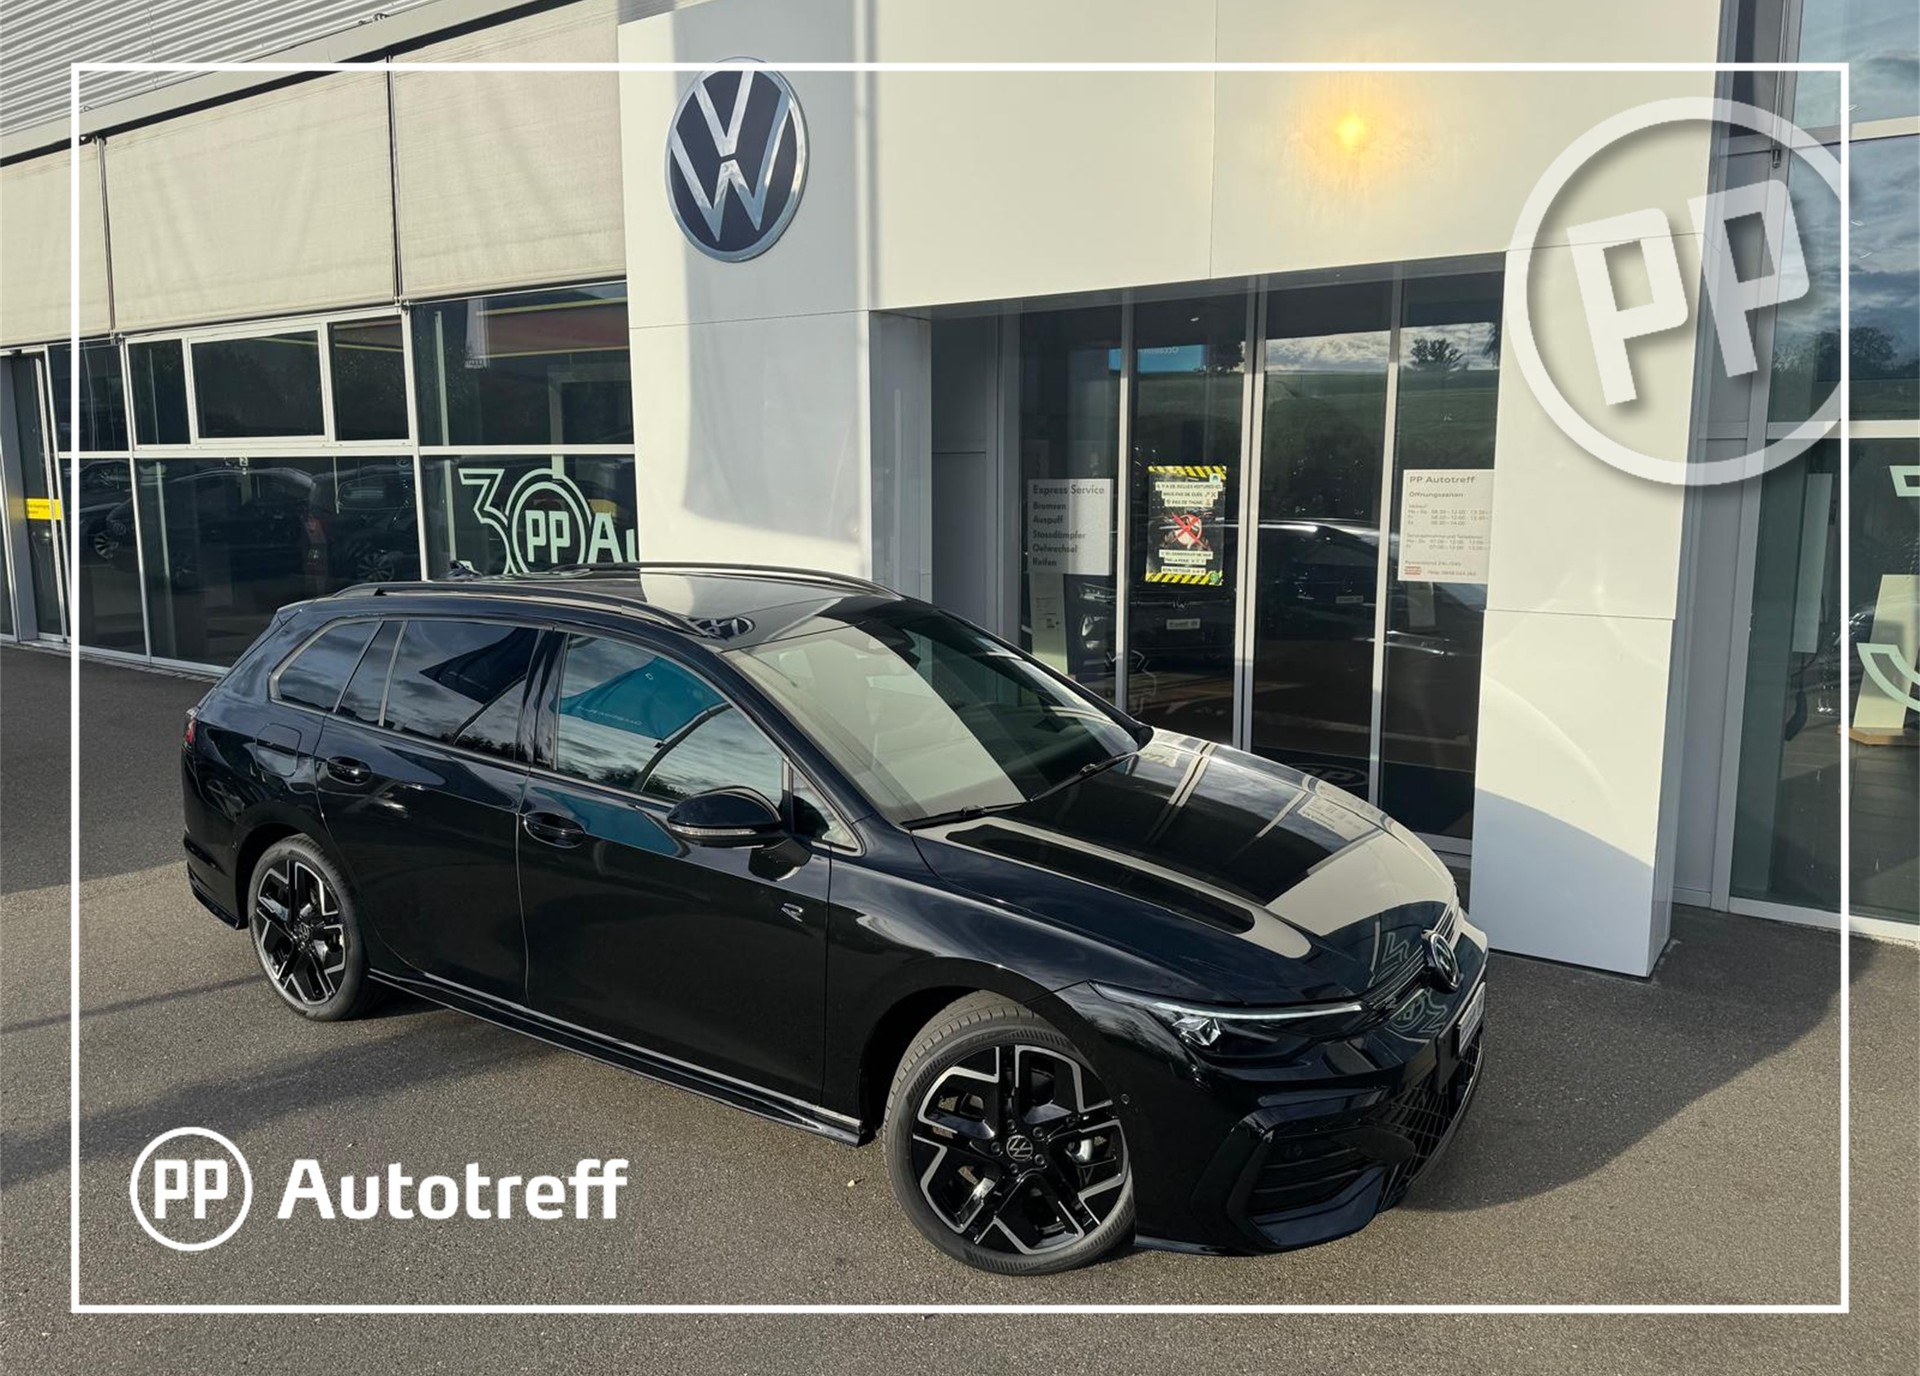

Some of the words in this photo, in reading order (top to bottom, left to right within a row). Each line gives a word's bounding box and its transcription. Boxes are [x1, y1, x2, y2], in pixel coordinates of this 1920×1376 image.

[669, 66, 797, 243] VW
[1033, 484, 1068, 495] Express
[1070, 484, 1105, 494] Service
[1425, 476, 1475, 484] Autotreff
[525, 510, 571, 564] PP
